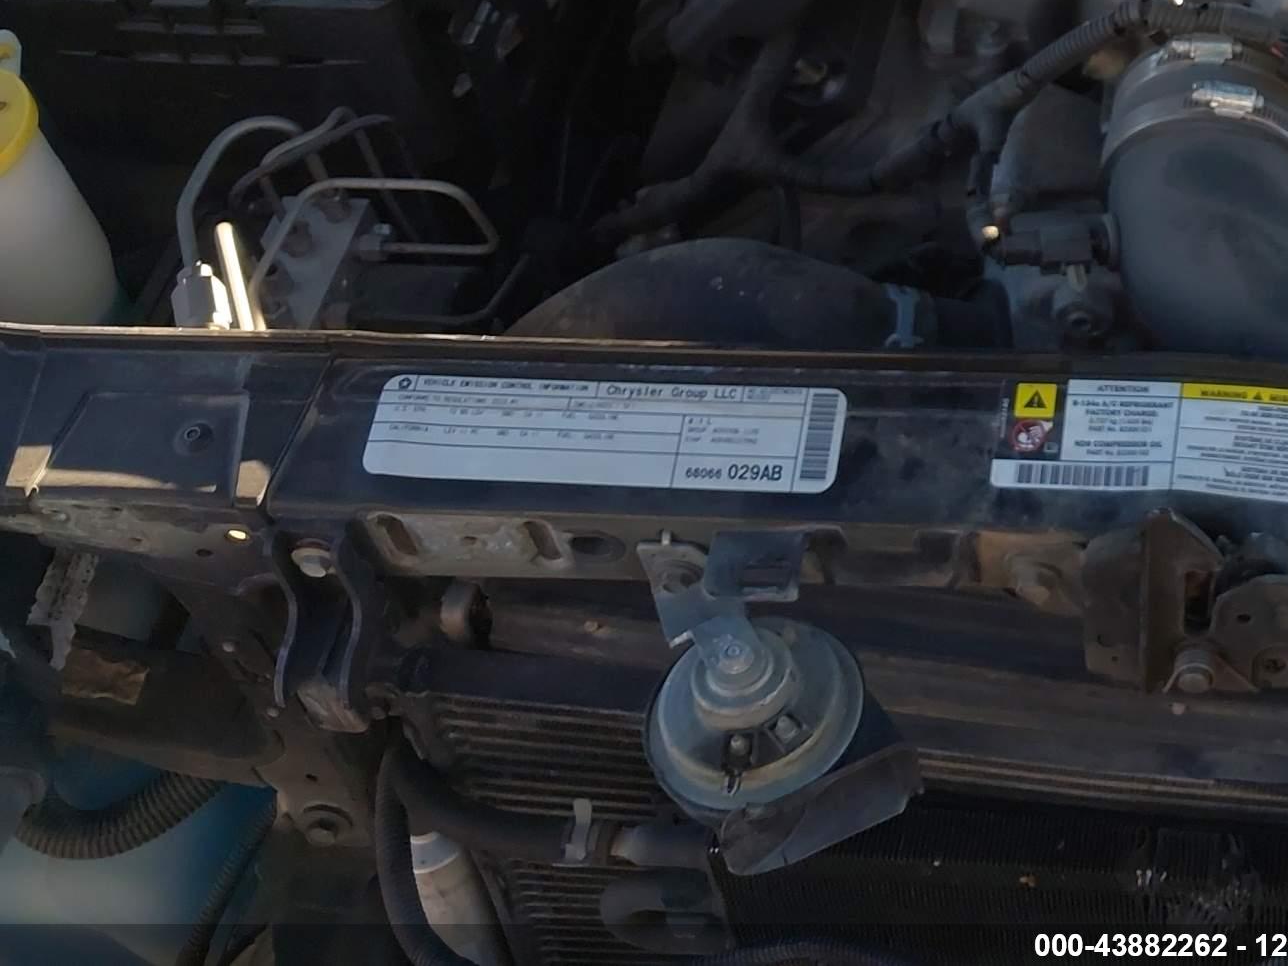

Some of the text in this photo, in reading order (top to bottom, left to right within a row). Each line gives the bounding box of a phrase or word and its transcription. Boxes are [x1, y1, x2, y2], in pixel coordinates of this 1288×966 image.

[424, 378, 456, 387] VEHICLE
[460, 380, 497, 389] EMISSION
[501, 381, 532, 390] CONTROL
[1097, 384, 1150, 393] ATTENTION
[606, 384, 663, 400] Chrysler
[671, 386, 708, 401] Group
[714, 386, 738, 399] LLC
[1200, 389, 1248, 400] WARNING
[728, 463, 784, 482] 029AB
